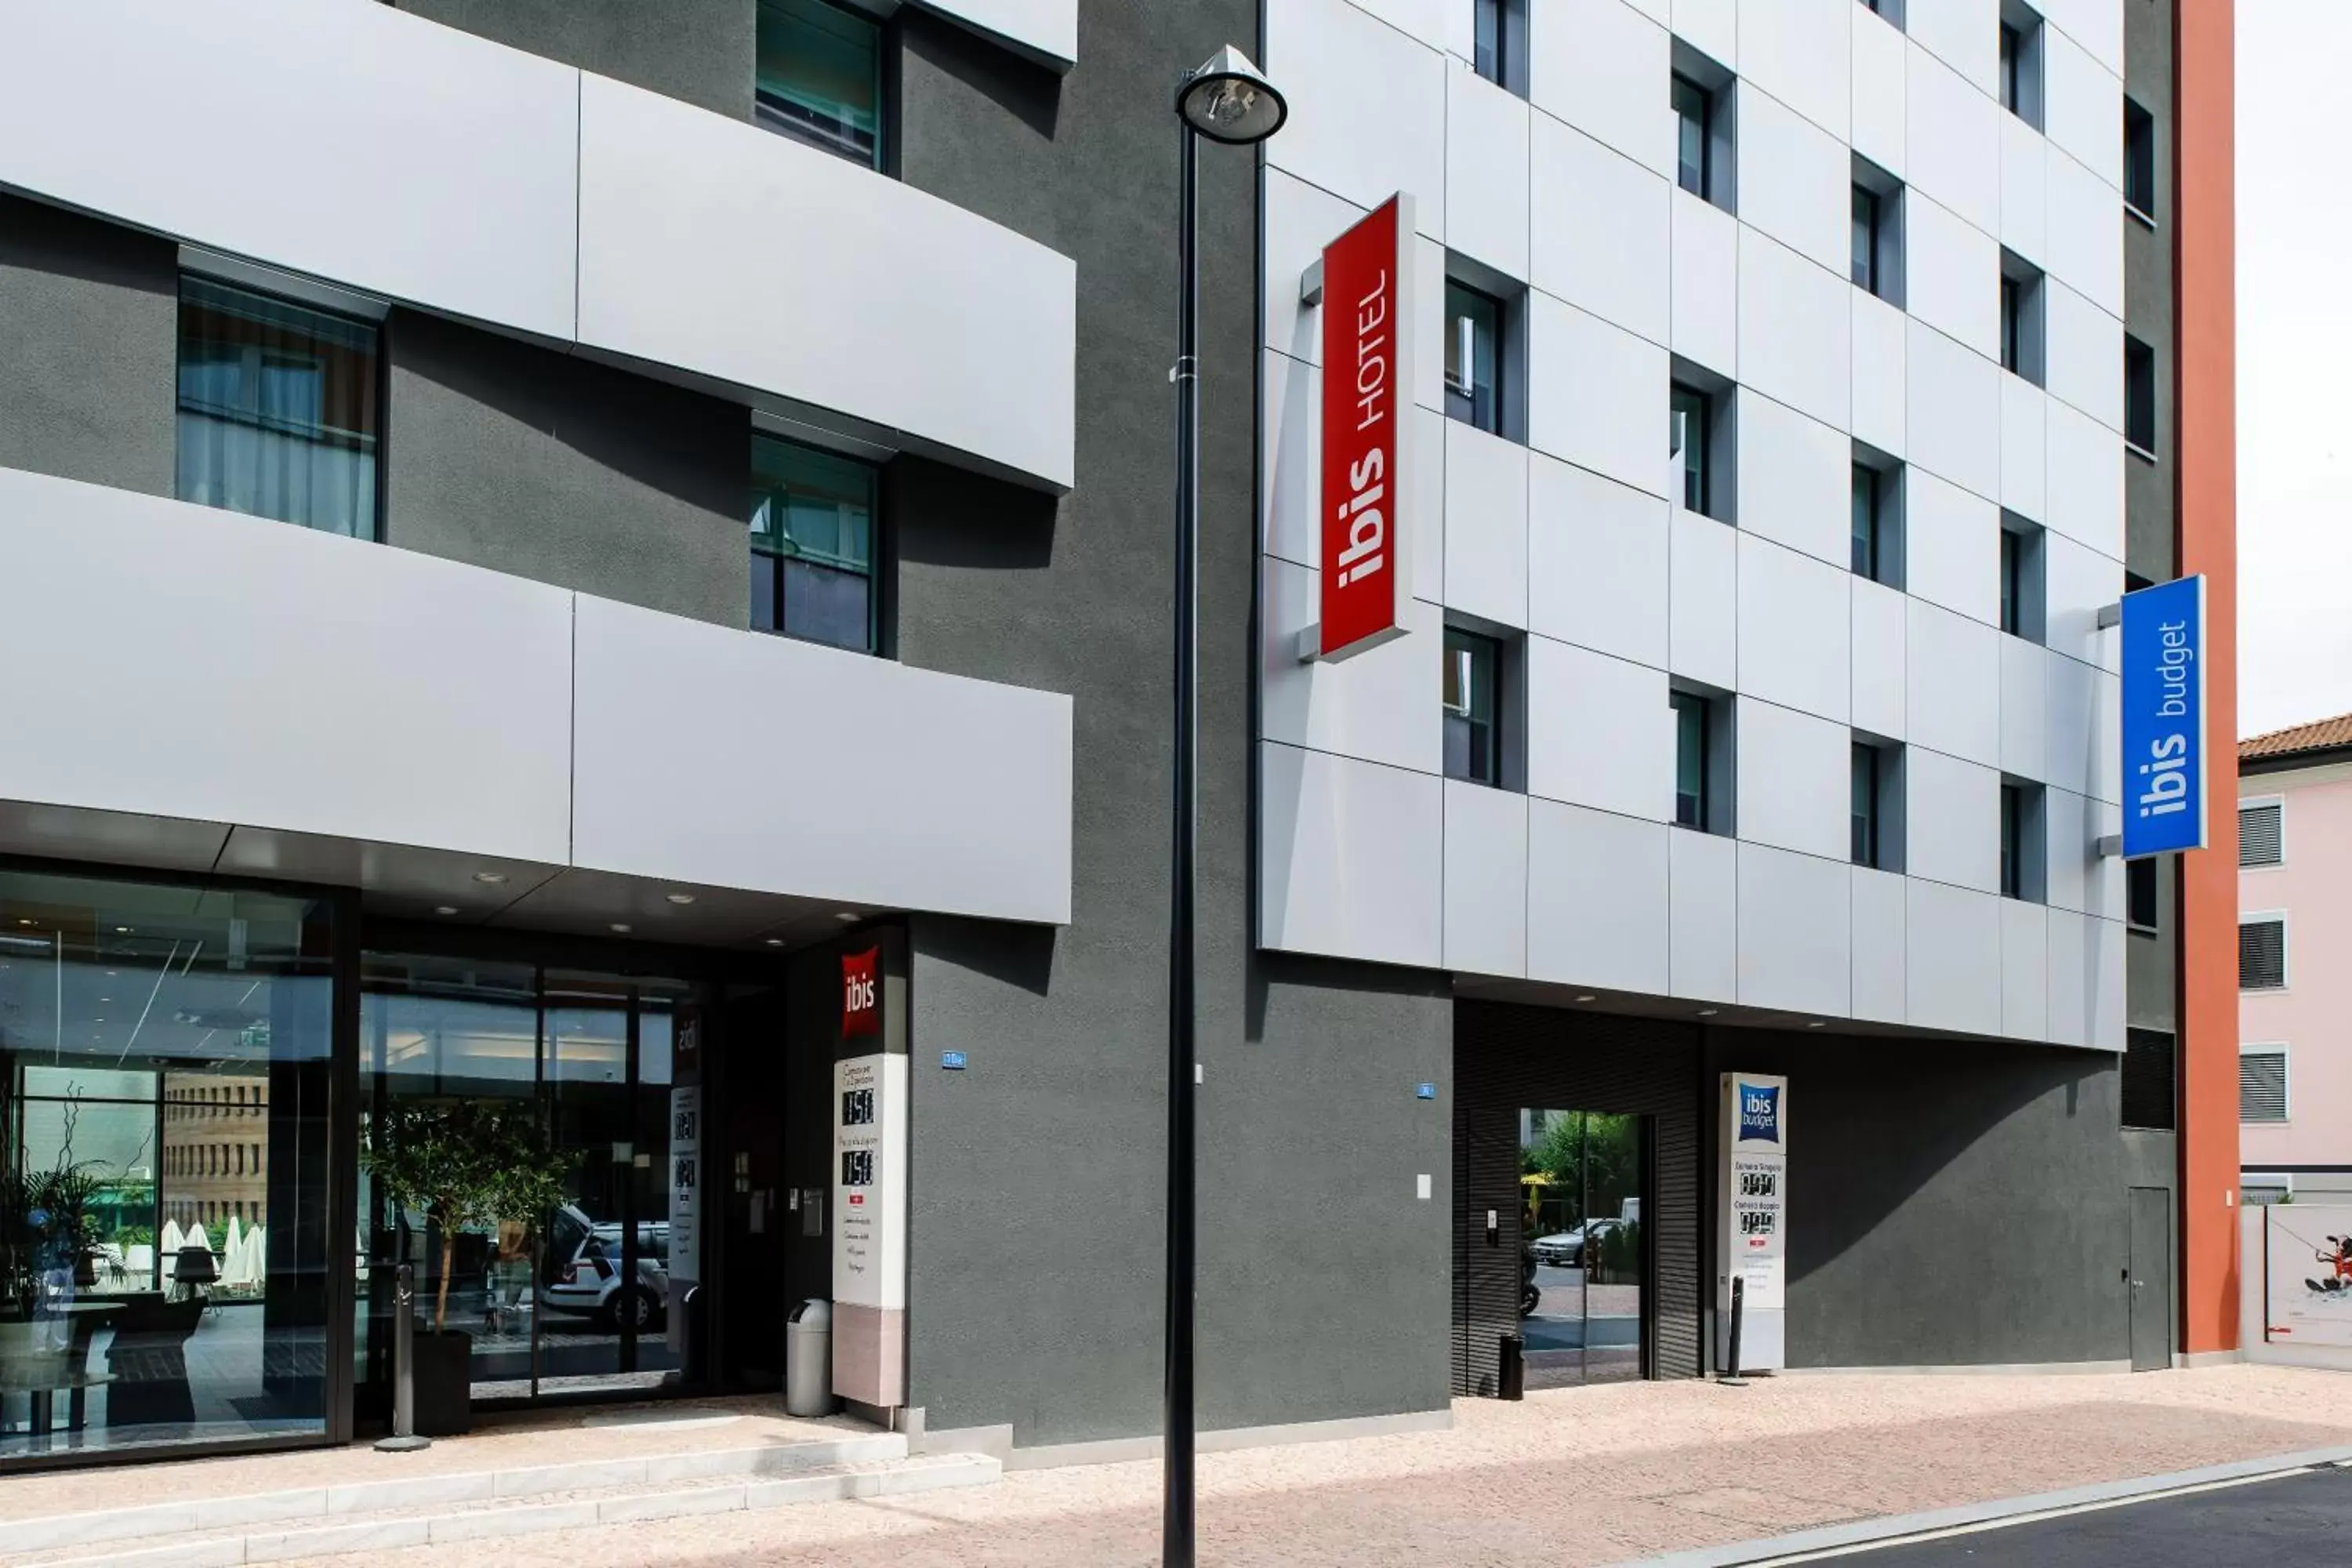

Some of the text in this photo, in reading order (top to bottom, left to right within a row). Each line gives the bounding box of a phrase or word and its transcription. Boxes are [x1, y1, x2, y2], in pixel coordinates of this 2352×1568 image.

[1338, 269, 1385, 588] ibis HOTEL
[2140, 620, 2193, 818] ibis budget
[847, 972, 874, 1012] ibis
[1743, 1112, 1774, 1130] budget
[1746, 1093, 1771, 1114] ibis
